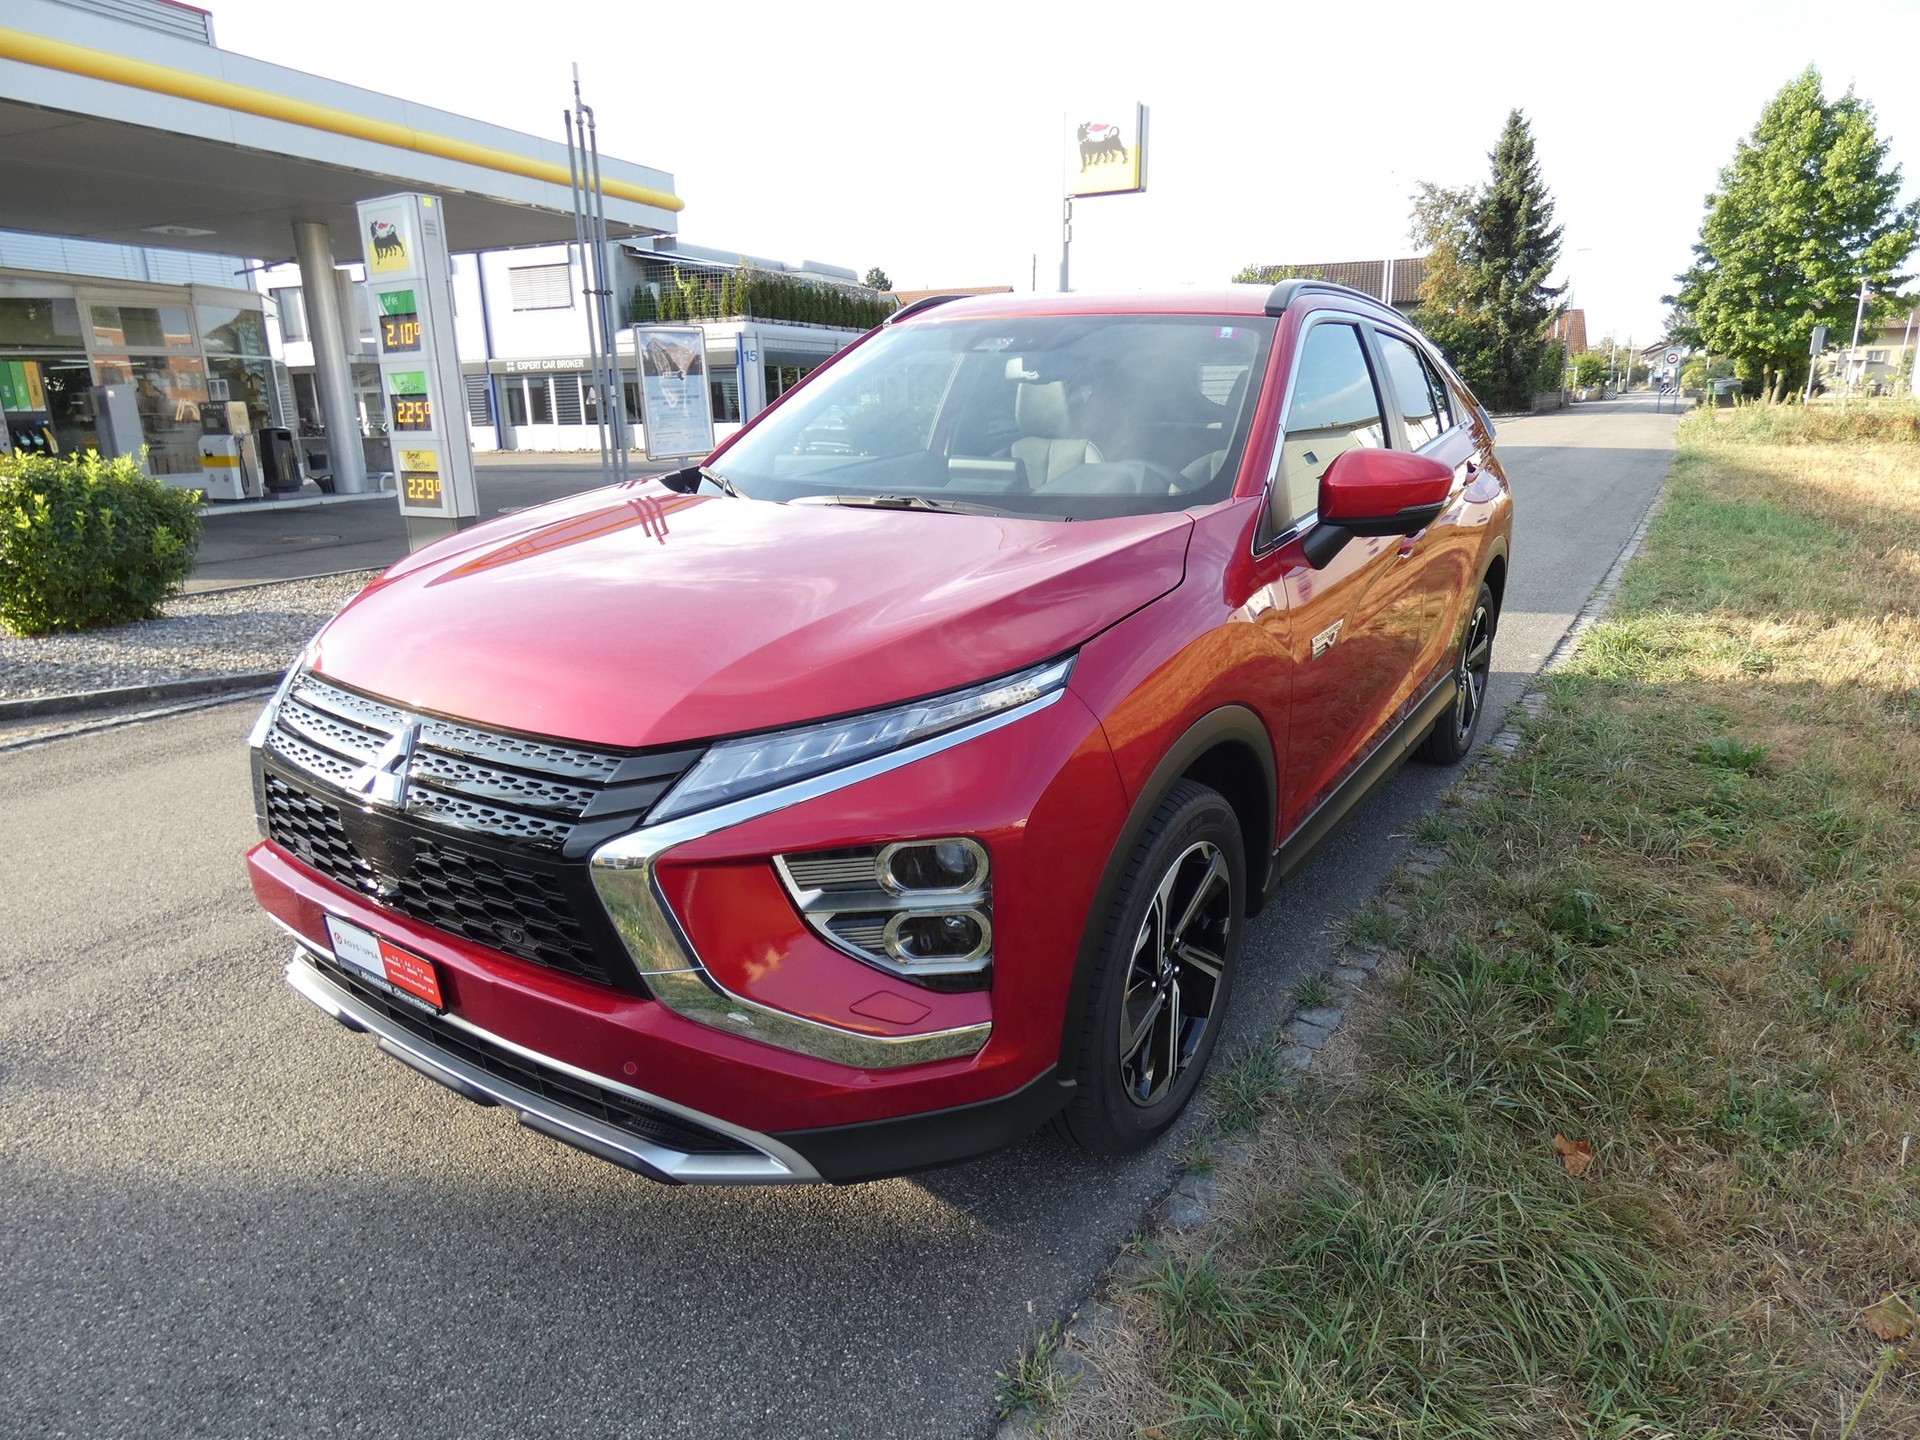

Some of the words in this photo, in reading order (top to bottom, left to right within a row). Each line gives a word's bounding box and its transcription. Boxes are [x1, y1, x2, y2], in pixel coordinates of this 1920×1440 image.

[743, 350, 758, 362] 15
[517, 361, 541, 370] EXPERT
[541, 360, 556, 369] CAR
[556, 359, 584, 369] BROKER
